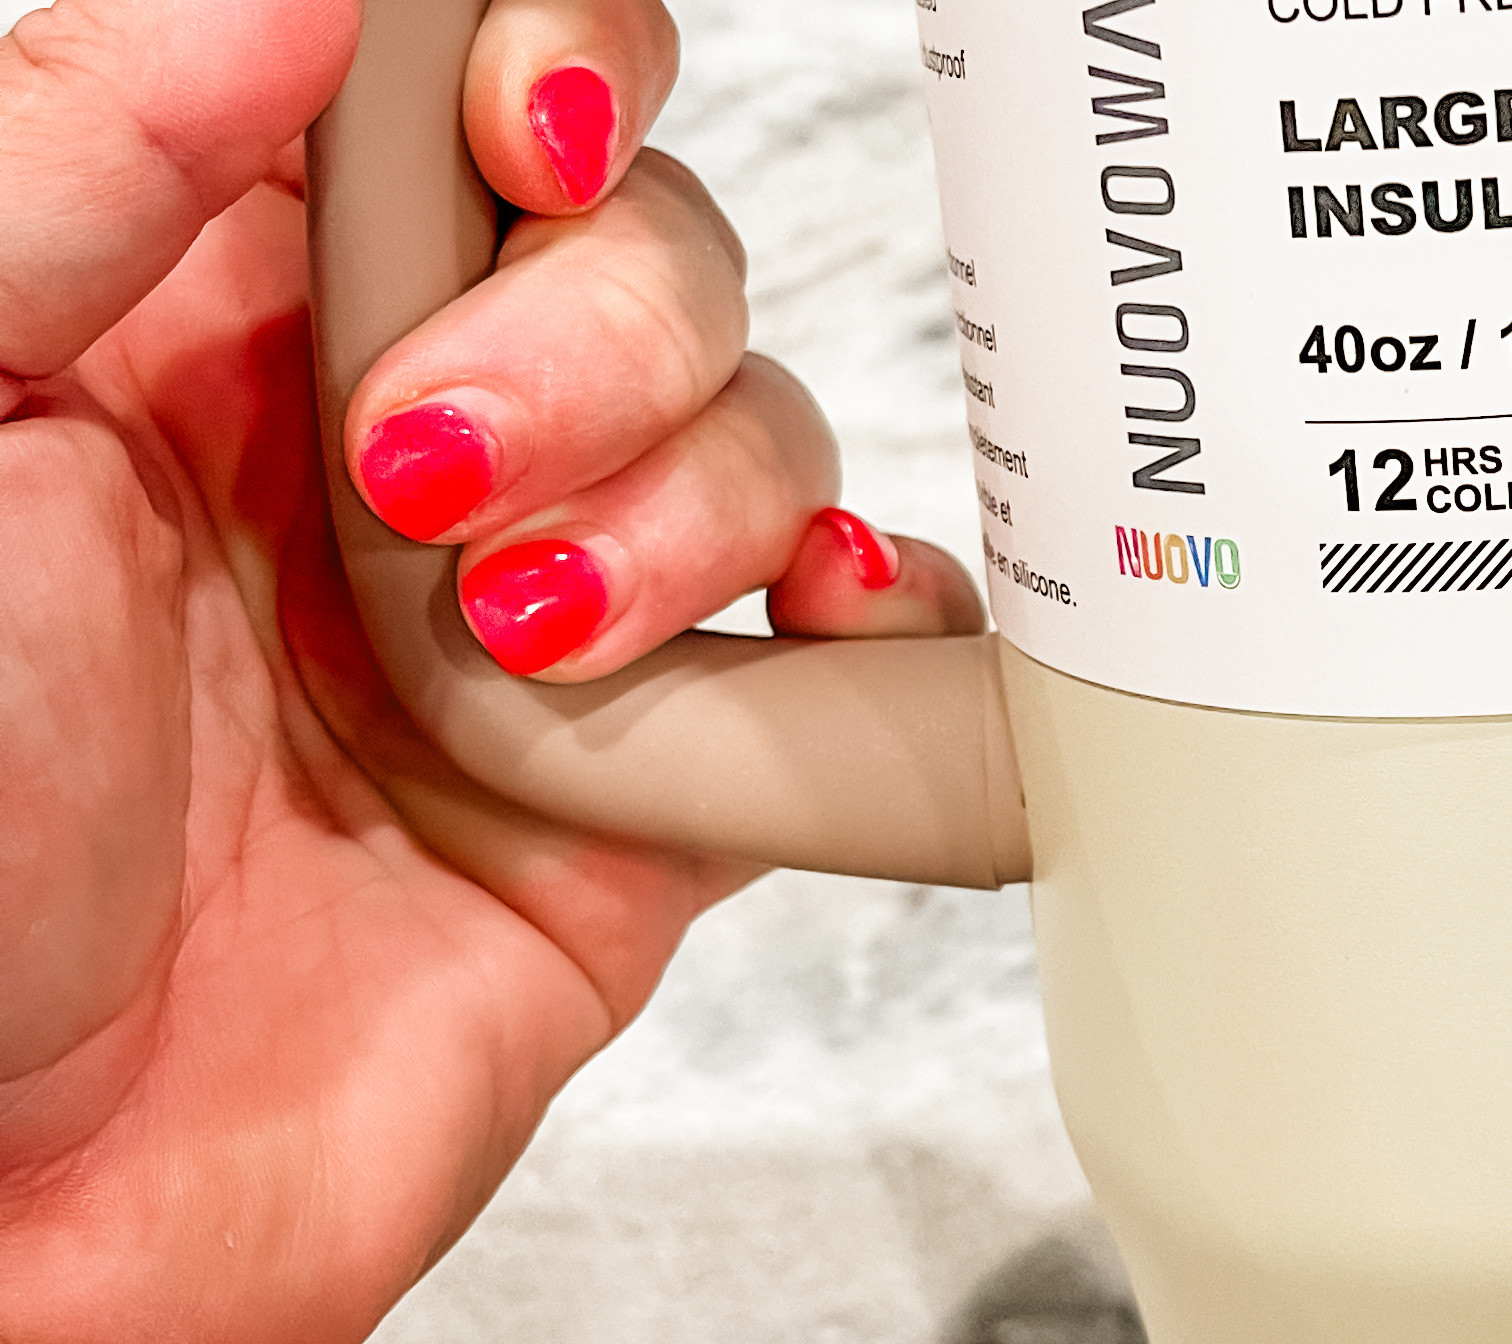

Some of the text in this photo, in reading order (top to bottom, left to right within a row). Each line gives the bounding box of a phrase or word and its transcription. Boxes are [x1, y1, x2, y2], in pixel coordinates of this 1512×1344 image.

[1298, 323, 1442, 374] 40oz
[1460, 318, 1477, 370] /
[1328, 448, 1418, 512] 12
[1424, 444, 1503, 477] HRS
[1000, 499, 1013, 527] et
[1114, 524, 1241, 589] NUOVO
[1012, 559, 1078, 607] silicone.
